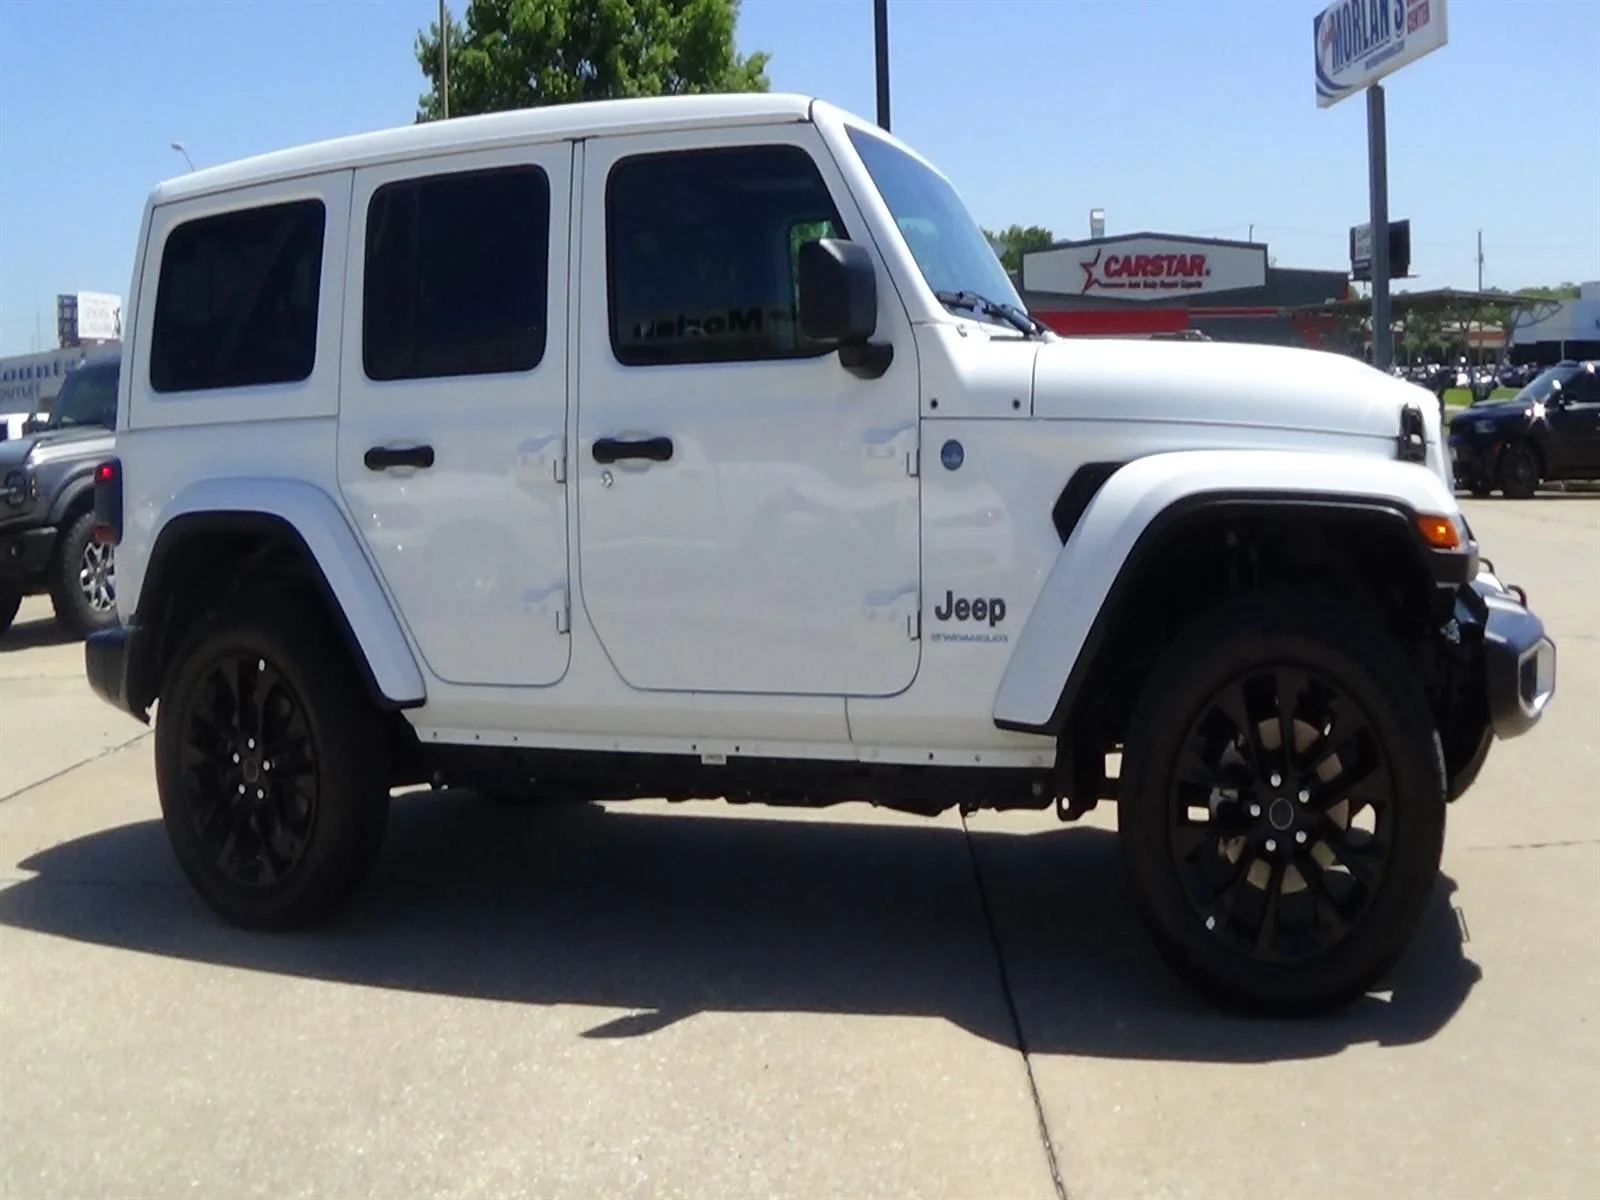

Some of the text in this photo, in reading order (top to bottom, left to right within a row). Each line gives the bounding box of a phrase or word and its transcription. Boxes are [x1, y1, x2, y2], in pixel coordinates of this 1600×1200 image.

[1331, 0, 1405, 71] MORLANS
[1103, 254, 1206, 278] CARSTAR
[935, 590, 1006, 627] Jeep
